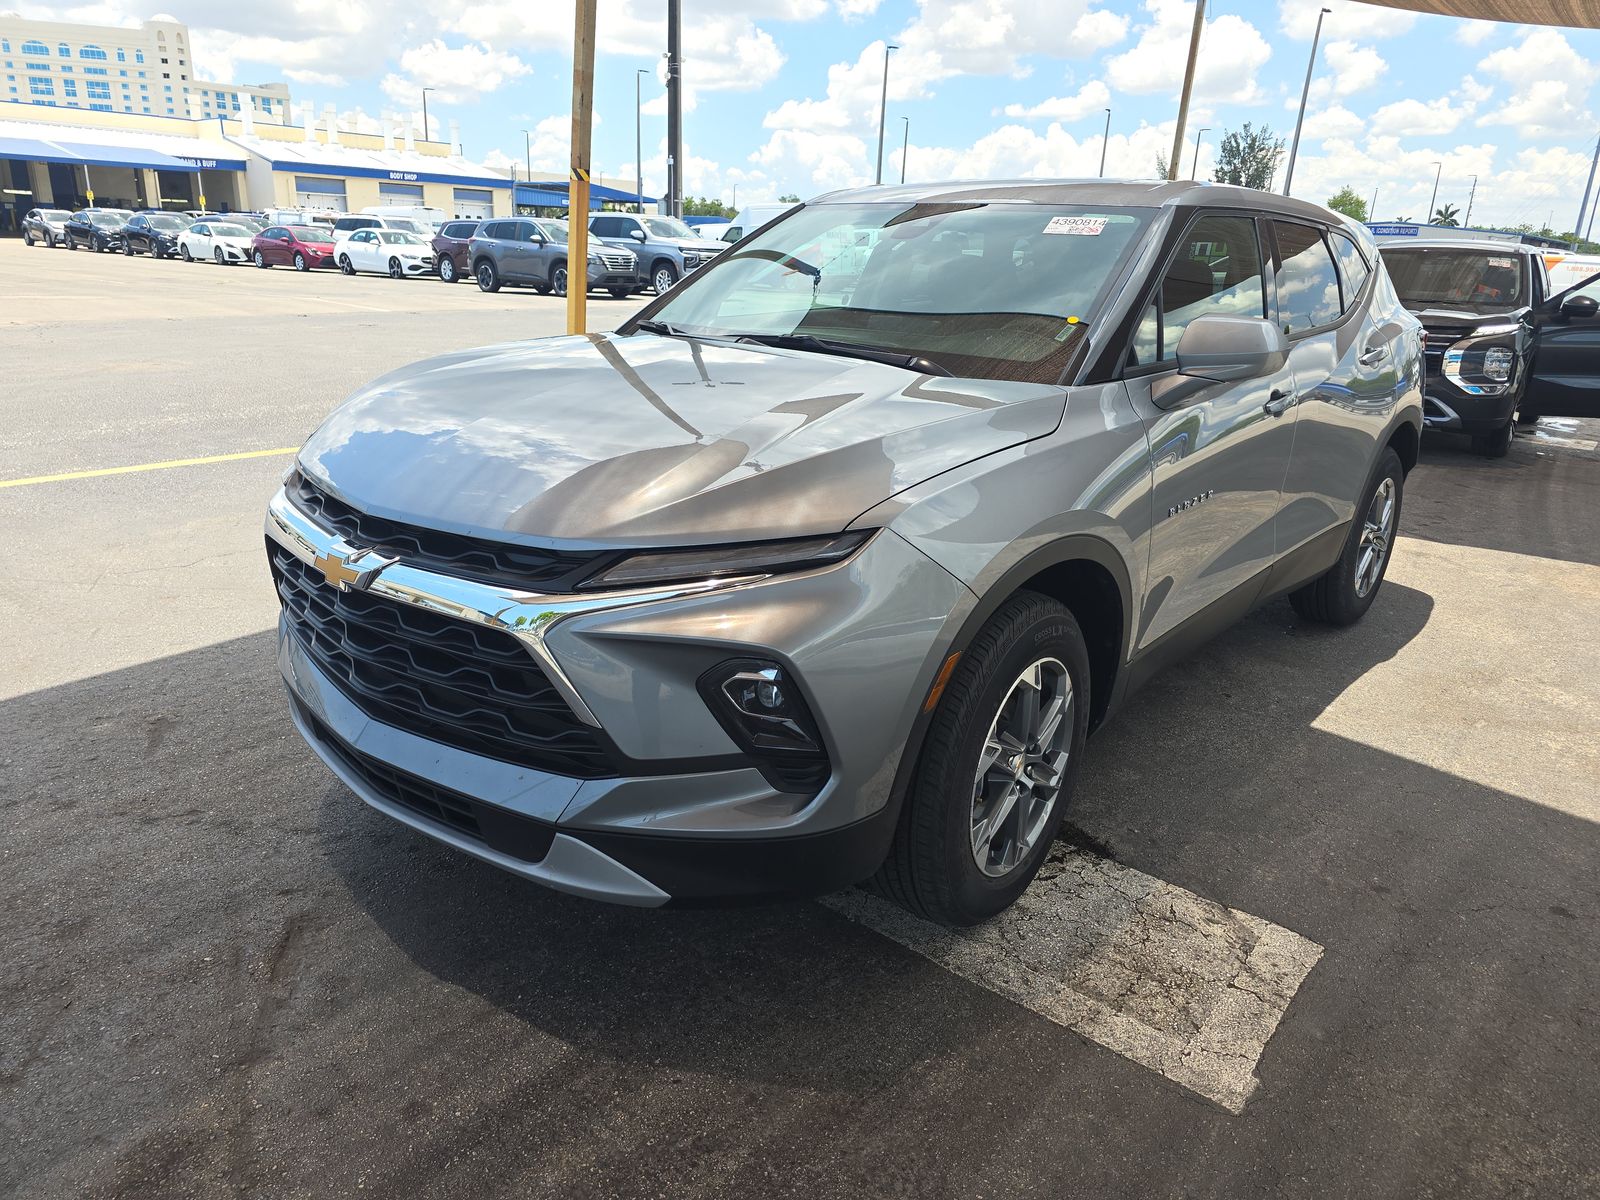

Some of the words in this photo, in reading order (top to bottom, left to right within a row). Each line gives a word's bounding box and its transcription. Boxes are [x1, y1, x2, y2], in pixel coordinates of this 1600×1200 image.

[389, 172, 403, 180] BODY
[403, 173, 418, 181] SHOP
[1051, 218, 1107, 227] 4390814
